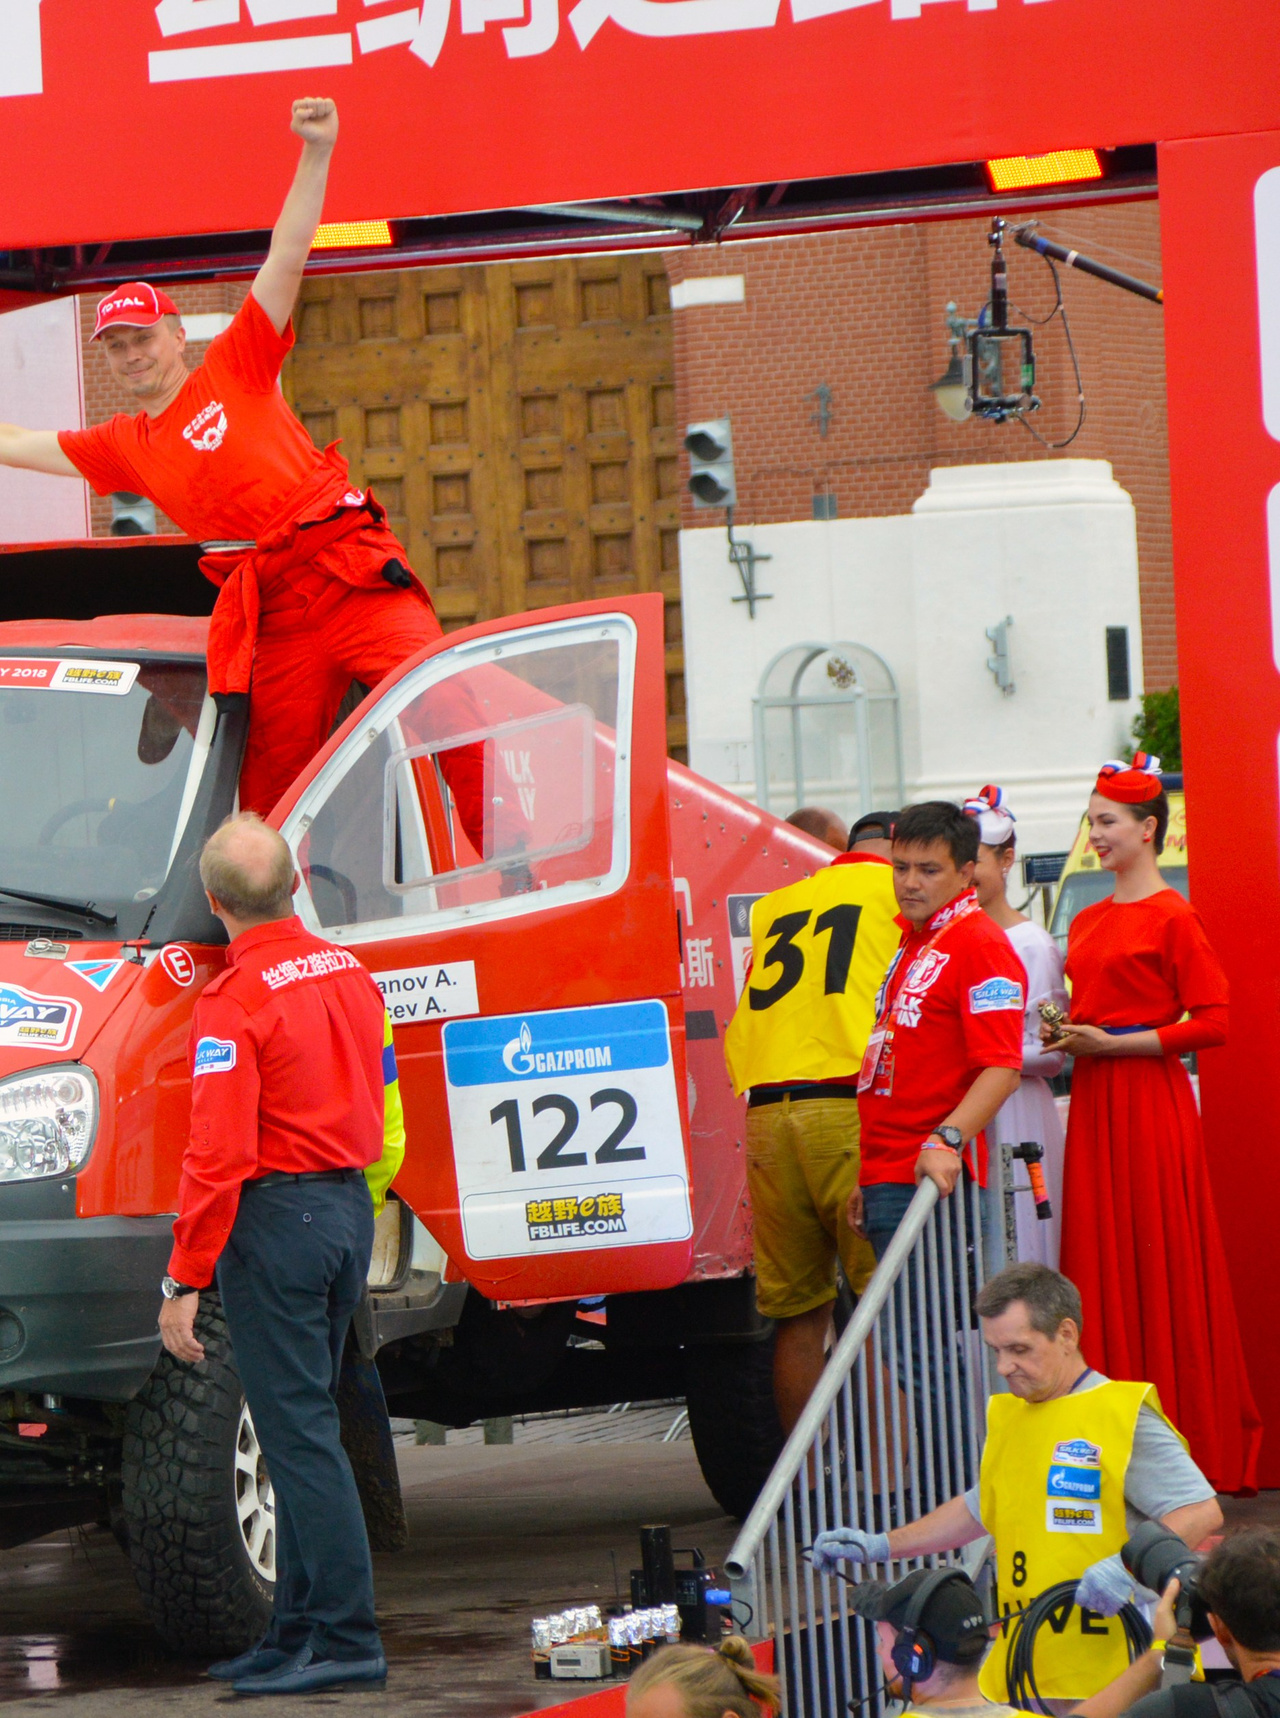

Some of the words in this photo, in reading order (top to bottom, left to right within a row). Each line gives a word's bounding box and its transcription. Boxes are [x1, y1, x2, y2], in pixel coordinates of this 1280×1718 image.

[101, 297, 144, 315] TOTAL
[11, 668, 48, 678] 2018
[167, 950, 191, 979] E
[749, 903, 863, 1011] 31
[376, 975, 429, 995] anov
[435, 968, 458, 988] A.
[425, 996, 447, 1015] A.
[206, 1047, 230, 1058] WAY
[535, 1046, 612, 1073] GAZPROM
[489, 1087, 646, 1173] 122
[526, 1193, 625, 1224] 越野e族
[529, 1217, 626, 1241] FBLIFE.COM
[1011, 1550, 1028, 1588] 8
